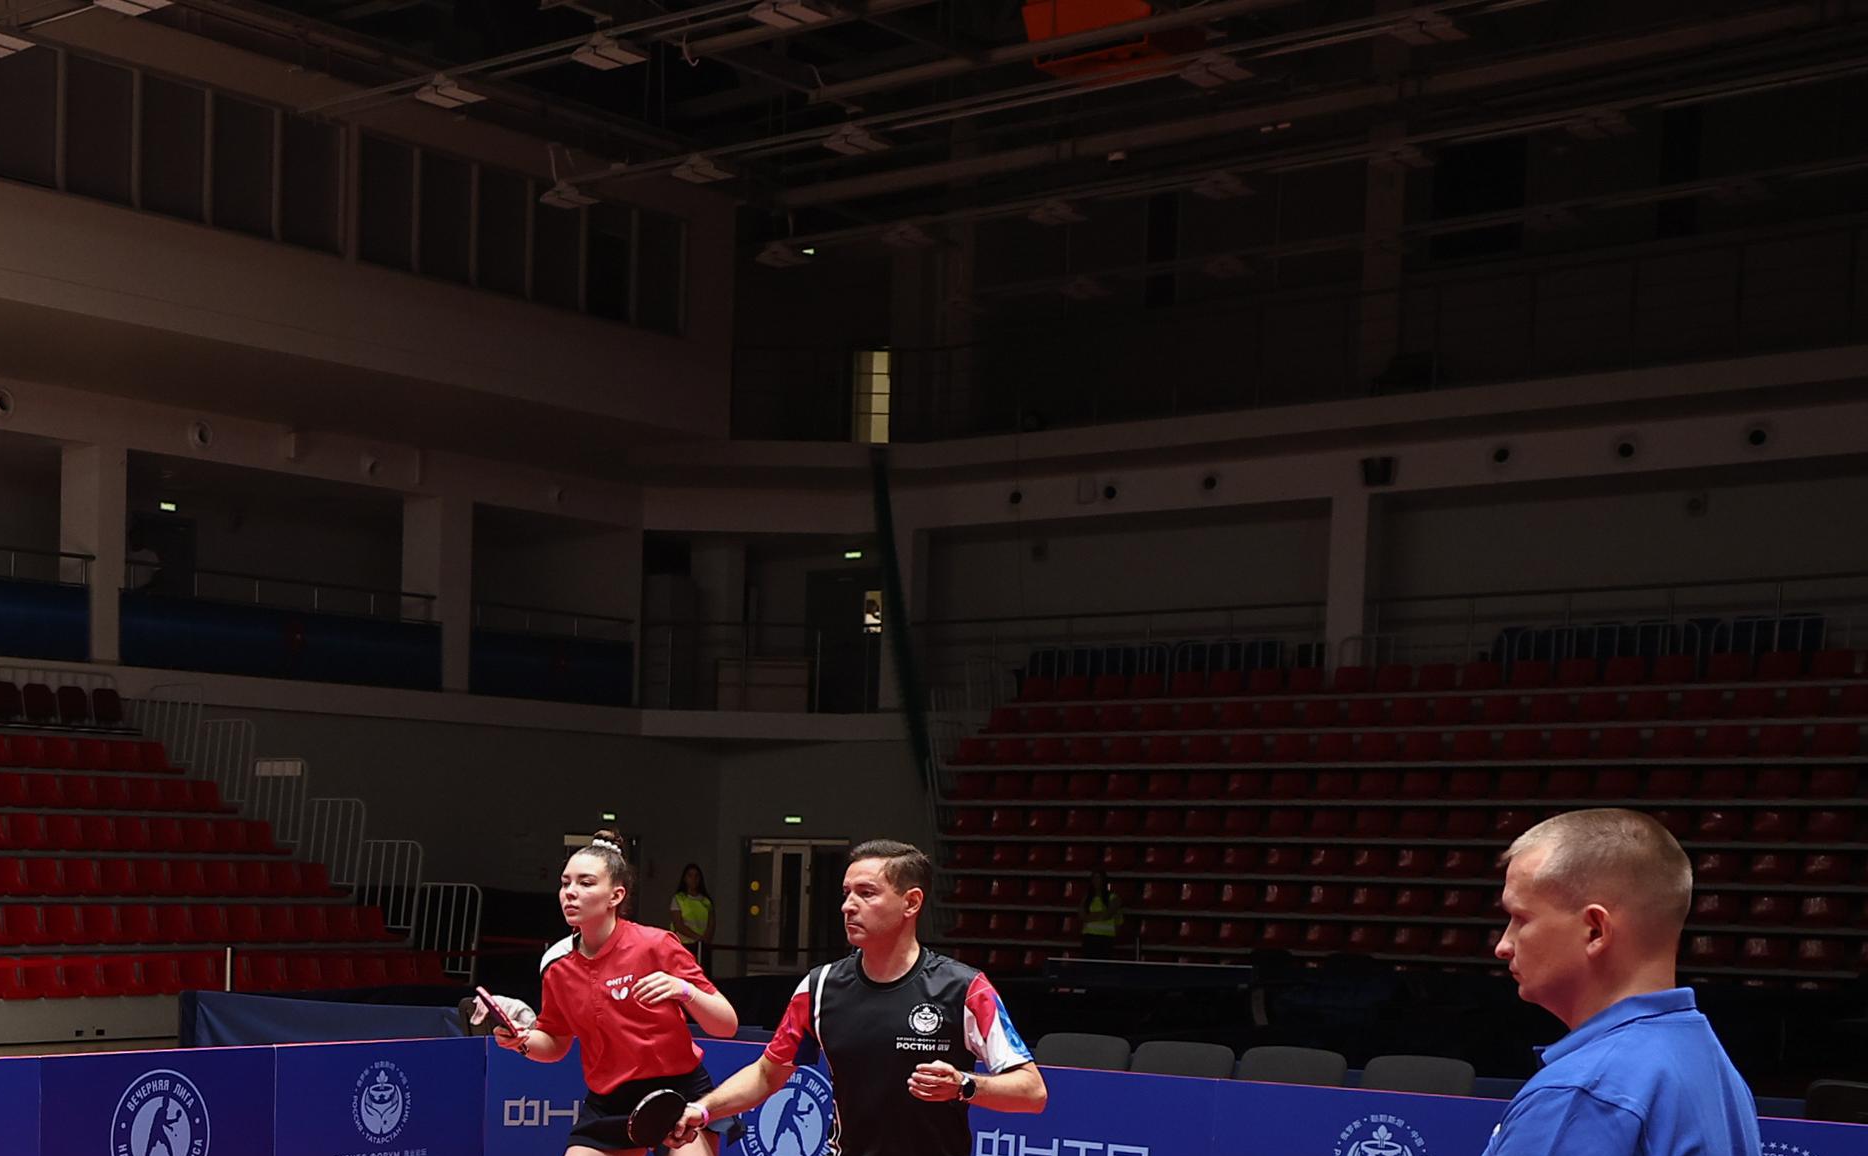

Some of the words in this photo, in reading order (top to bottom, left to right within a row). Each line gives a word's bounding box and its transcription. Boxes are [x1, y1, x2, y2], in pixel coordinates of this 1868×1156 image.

[896, 1042, 936, 1051] РОСТКИ
[126, 1079, 170, 1112] ВЕЧЕРНЯЯ
[173, 1083, 195, 1109] ЛИГА
[806, 1079, 829, 1104] ЛИГА
[365, 1127, 402, 1144] ТАТАРСТАН
